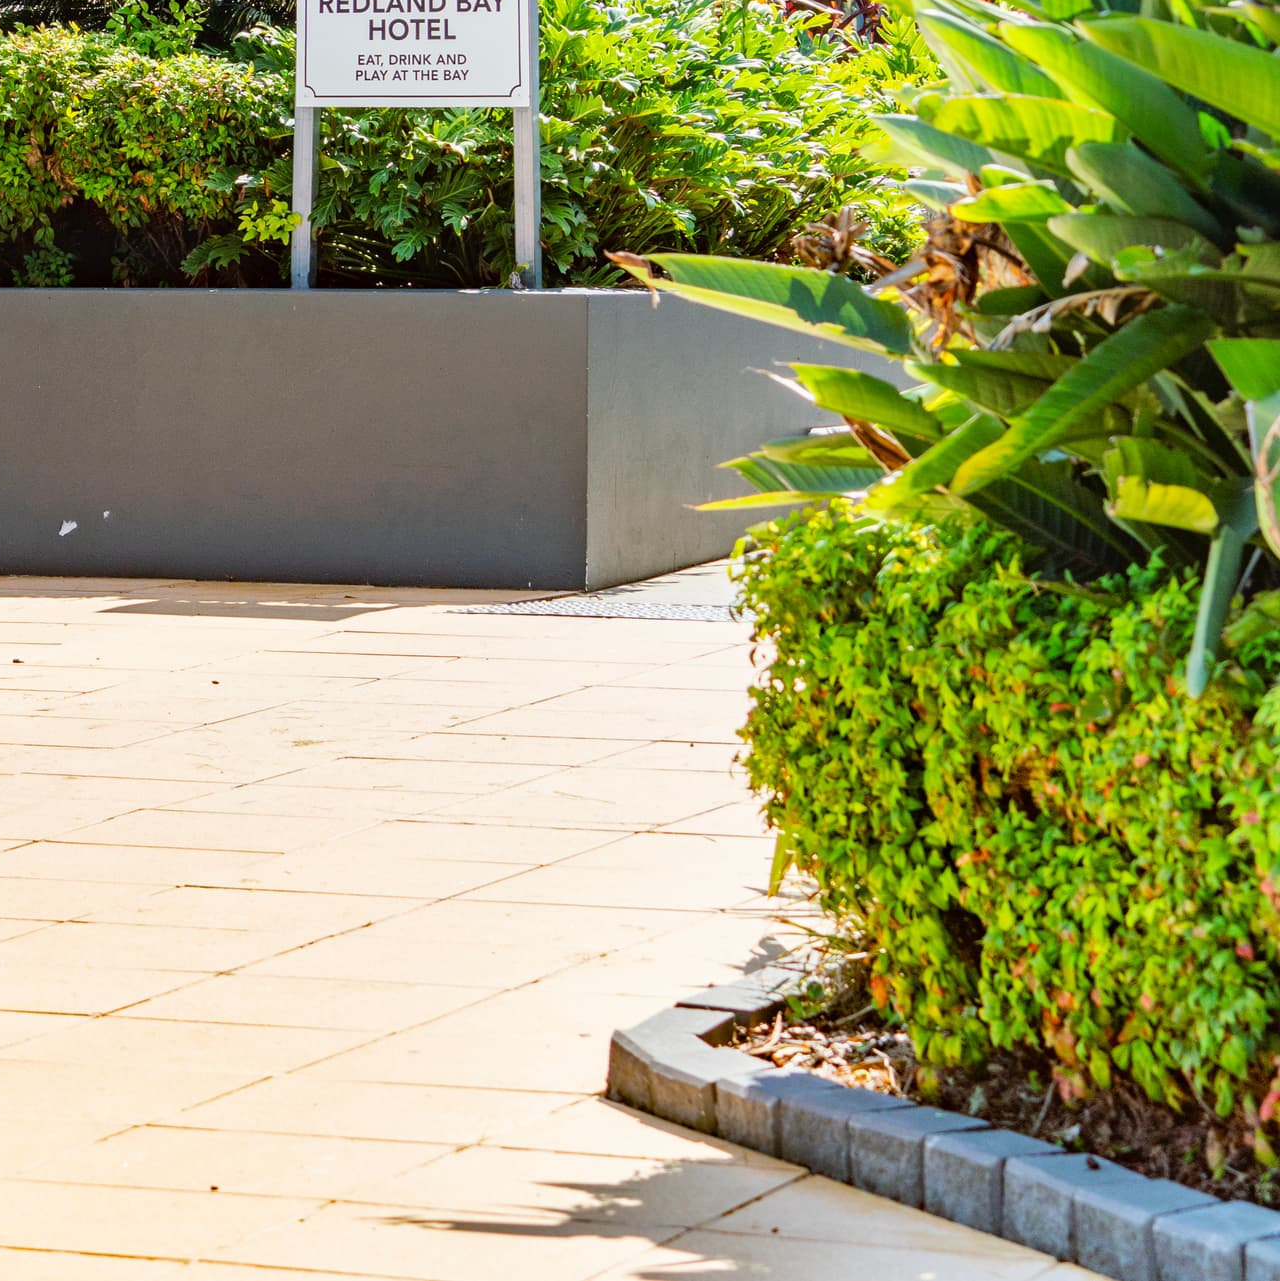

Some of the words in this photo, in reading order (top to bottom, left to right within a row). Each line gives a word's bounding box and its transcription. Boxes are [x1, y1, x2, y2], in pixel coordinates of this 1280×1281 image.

[368, 18, 457, 41] HOTEL
[357, 54, 384, 67] EAT,
[388, 54, 432, 66] DRINK
[435, 53, 467, 65] AND
[355, 69, 388, 81] PLAY
[391, 69, 409, 81] AT
[412, 69, 439, 81] THE
[443, 69, 469, 81] BAY
